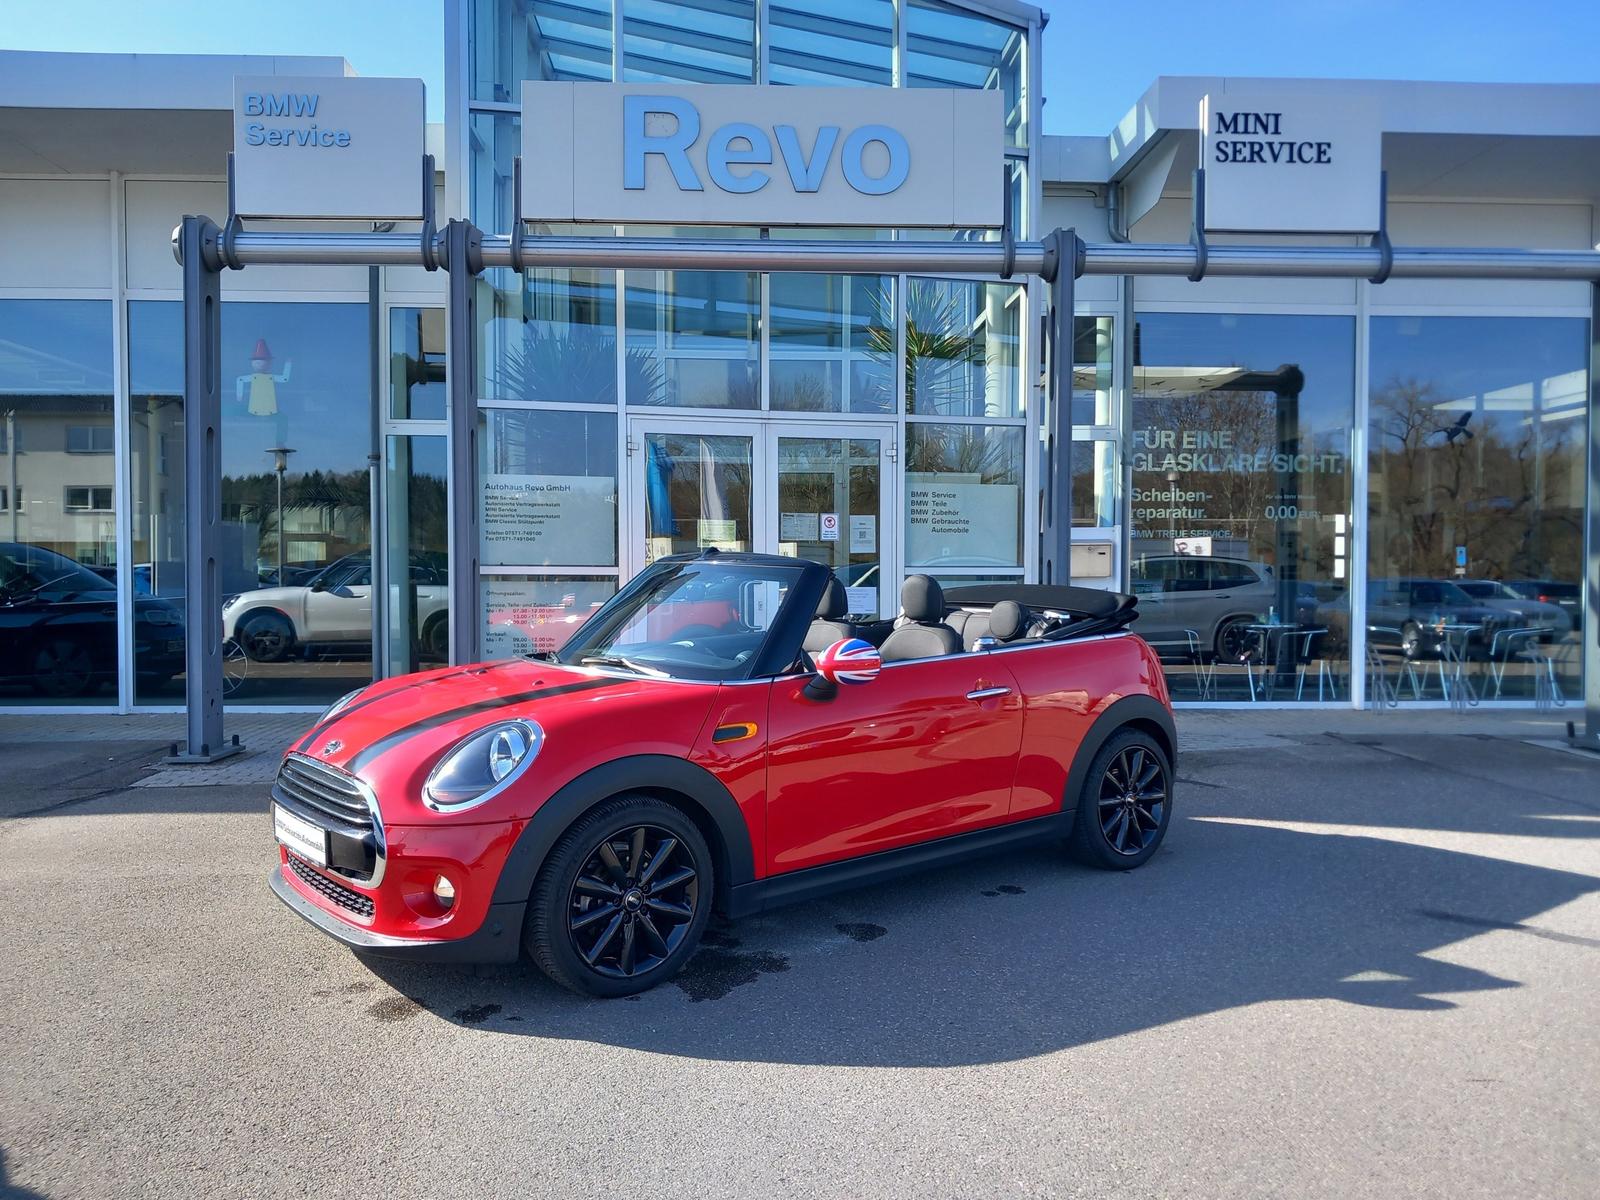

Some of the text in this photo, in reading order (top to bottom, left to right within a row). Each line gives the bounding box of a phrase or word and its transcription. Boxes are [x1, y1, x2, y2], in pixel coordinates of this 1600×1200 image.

[243, 93, 319, 118] BMW
[1215, 112, 1282, 135] MINI
[244, 122, 352, 148] Service
[623, 95, 911, 196] Revo
[1215, 140, 1332, 164] SERVICE
[1132, 425, 1232, 449] FÜR EINE
[1132, 452, 1342, 473] GLASKLARE SICHT.
[485, 483, 571, 492] Autohaus Revo GmbH
[1131, 488, 1213, 502] Scheiben-
[1131, 506, 1208, 522] reparatur.
[1265, 505, 1298, 522] 0,00
[1157, 529, 1187, 538] TREUE
